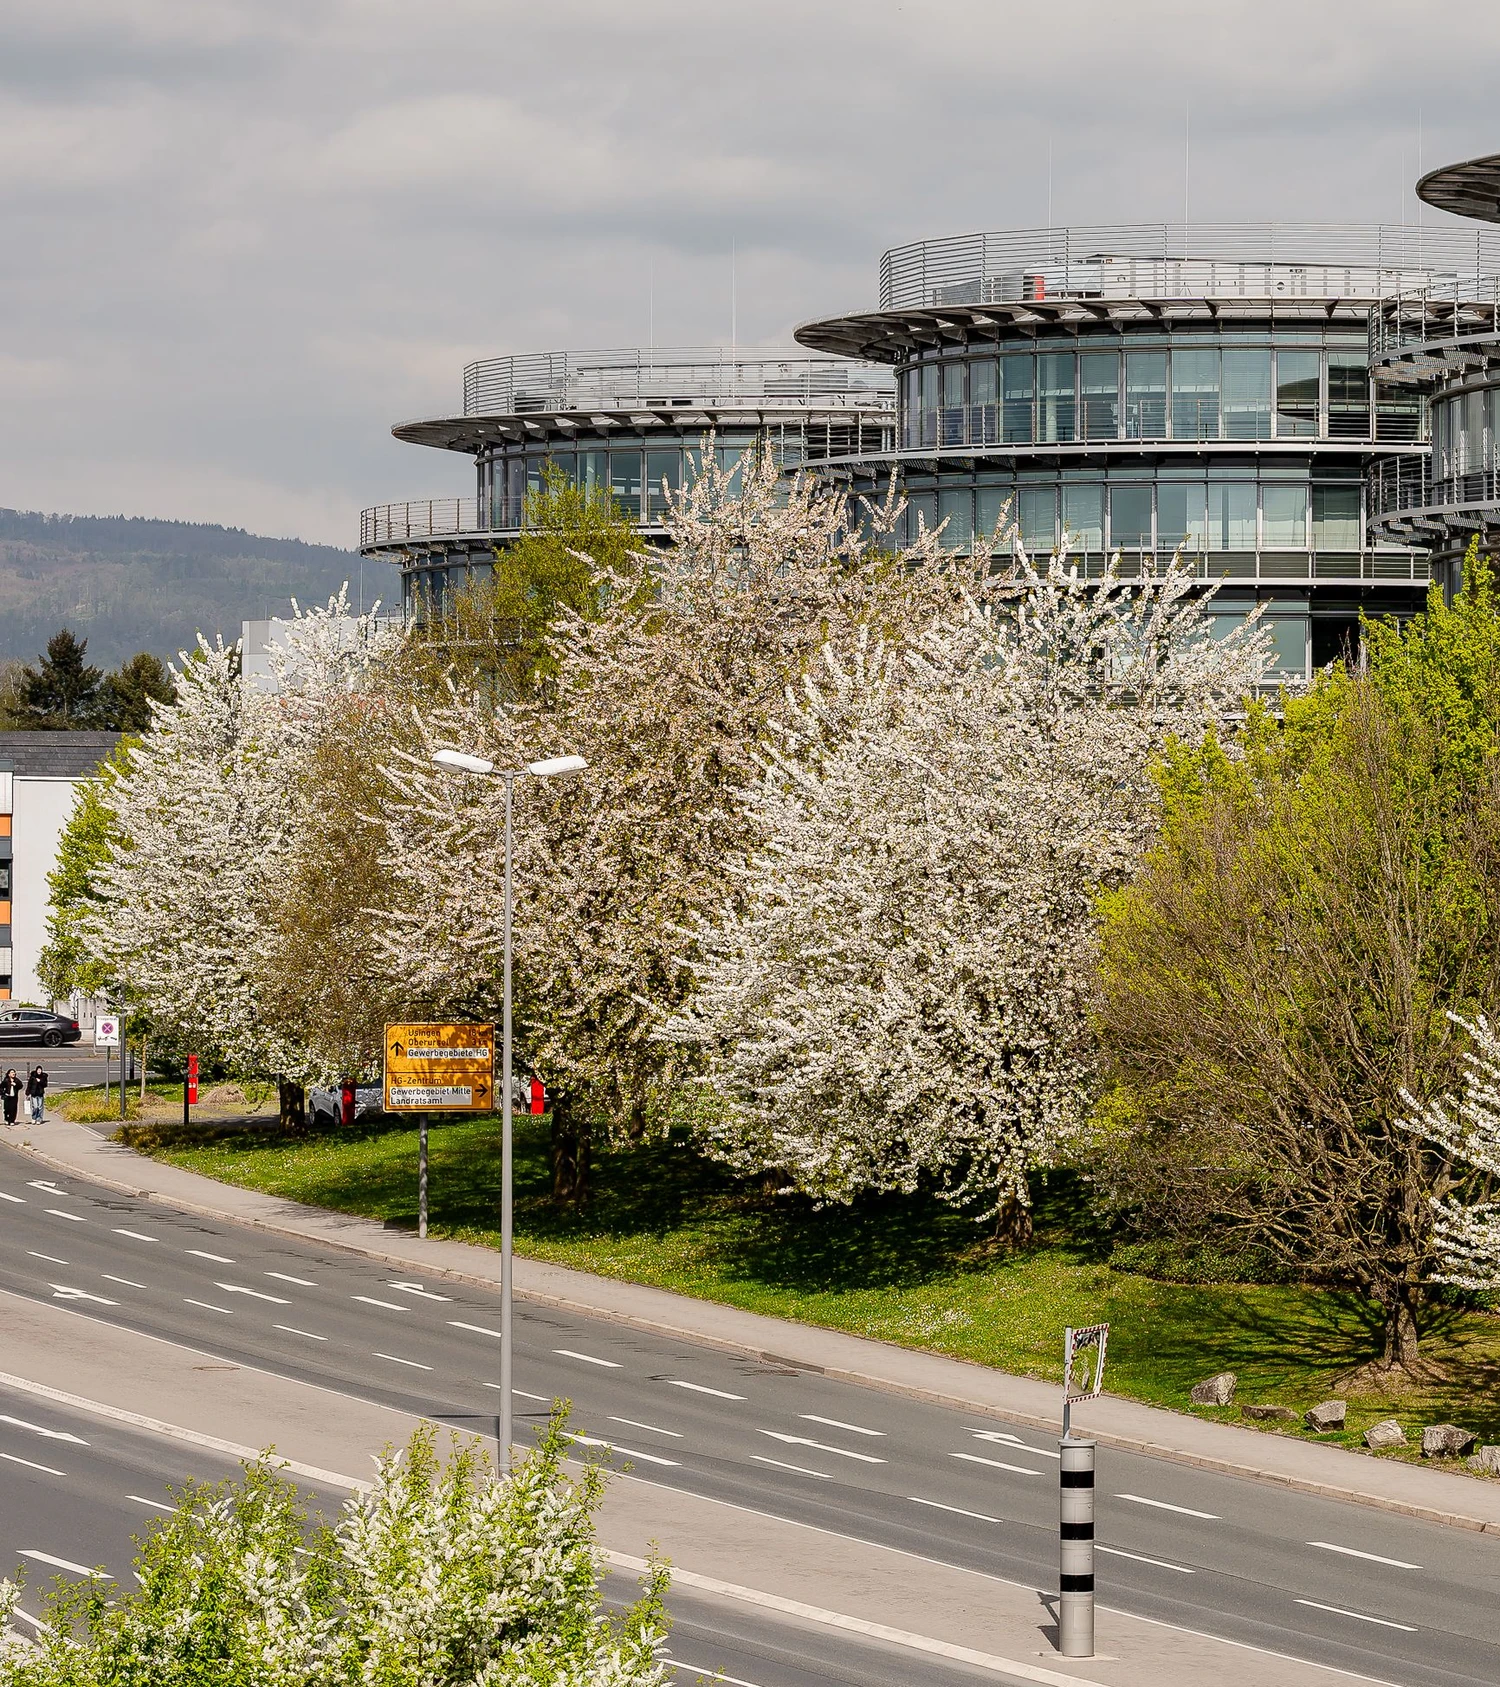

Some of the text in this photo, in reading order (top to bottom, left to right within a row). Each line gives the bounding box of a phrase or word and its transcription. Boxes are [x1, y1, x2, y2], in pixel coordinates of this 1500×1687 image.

[408, 1029, 440, 1038] Usingen
[408, 1049, 488, 1058] Gewerbegebiete HG
[390, 1087, 471, 1097] Gewerbegebiet Mitte
[390, 1097, 443, 1105] Landratsamt
